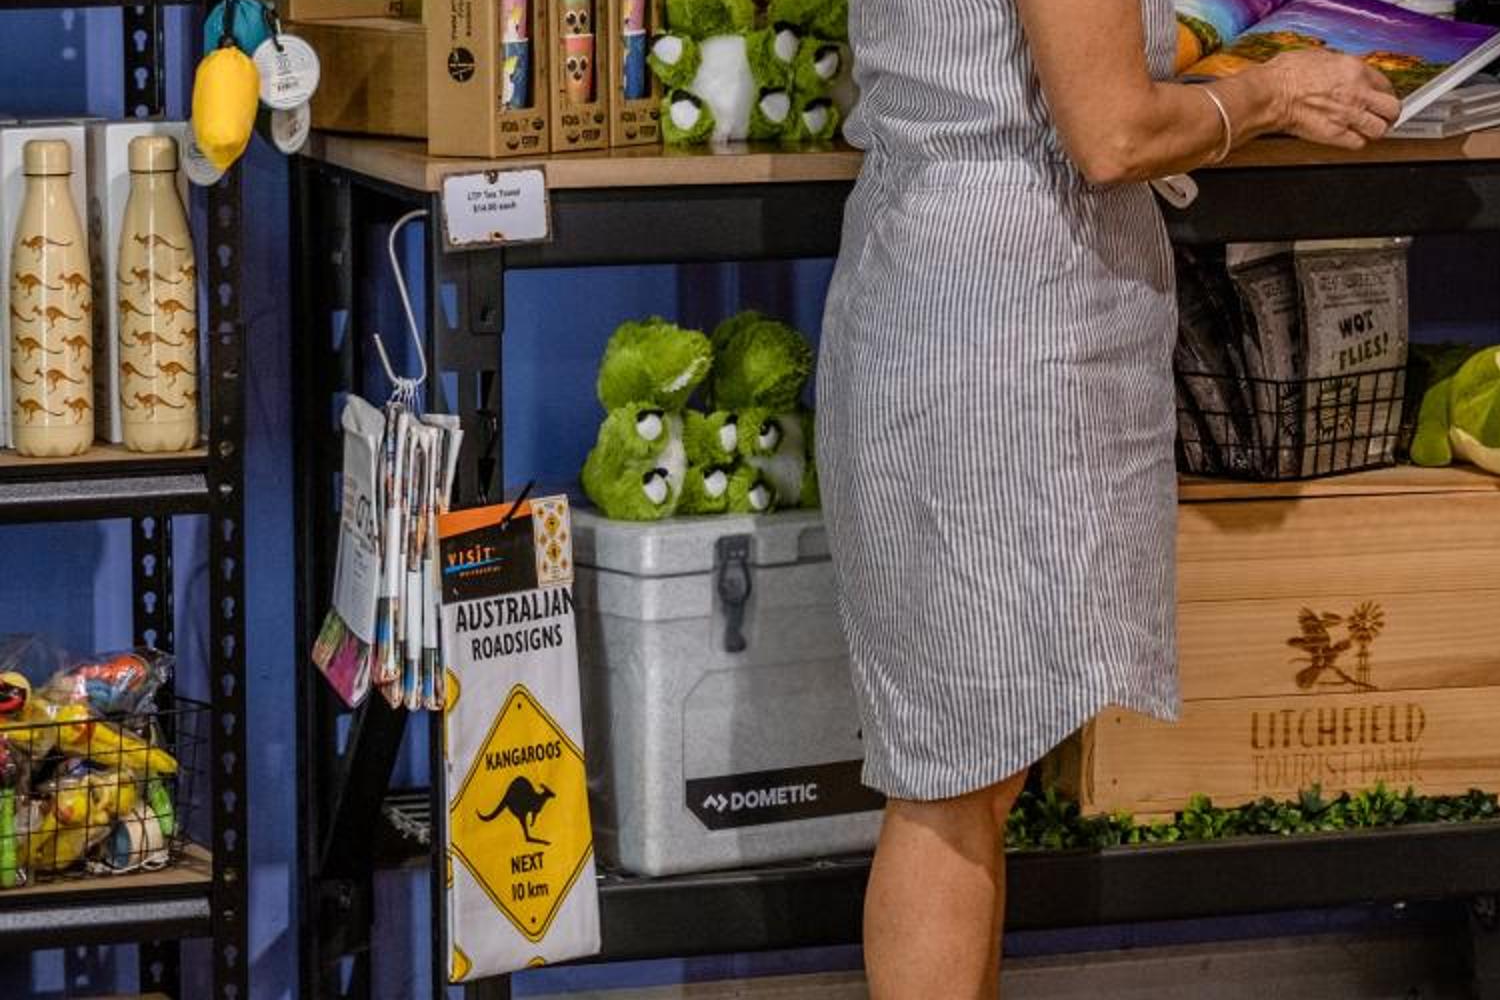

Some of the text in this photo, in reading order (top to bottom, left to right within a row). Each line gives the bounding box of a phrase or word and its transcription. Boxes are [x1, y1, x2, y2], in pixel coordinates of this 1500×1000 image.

[1337, 310, 1375, 340] WOT
[1338, 332, 1389, 372] FLIES!
[455, 587, 576, 633] AUSTRALIAN
[471, 624, 564, 662] ROADSIGNS
[1251, 703, 1426, 750] LITCHFIELD
[485, 739, 562, 772] KANGAROOS
[1251, 751, 1354, 792] TOURIST
[730, 783, 818, 811] DOMETIC
[511, 851, 545, 875] NEXT
[511, 880, 549, 901] 10 km
